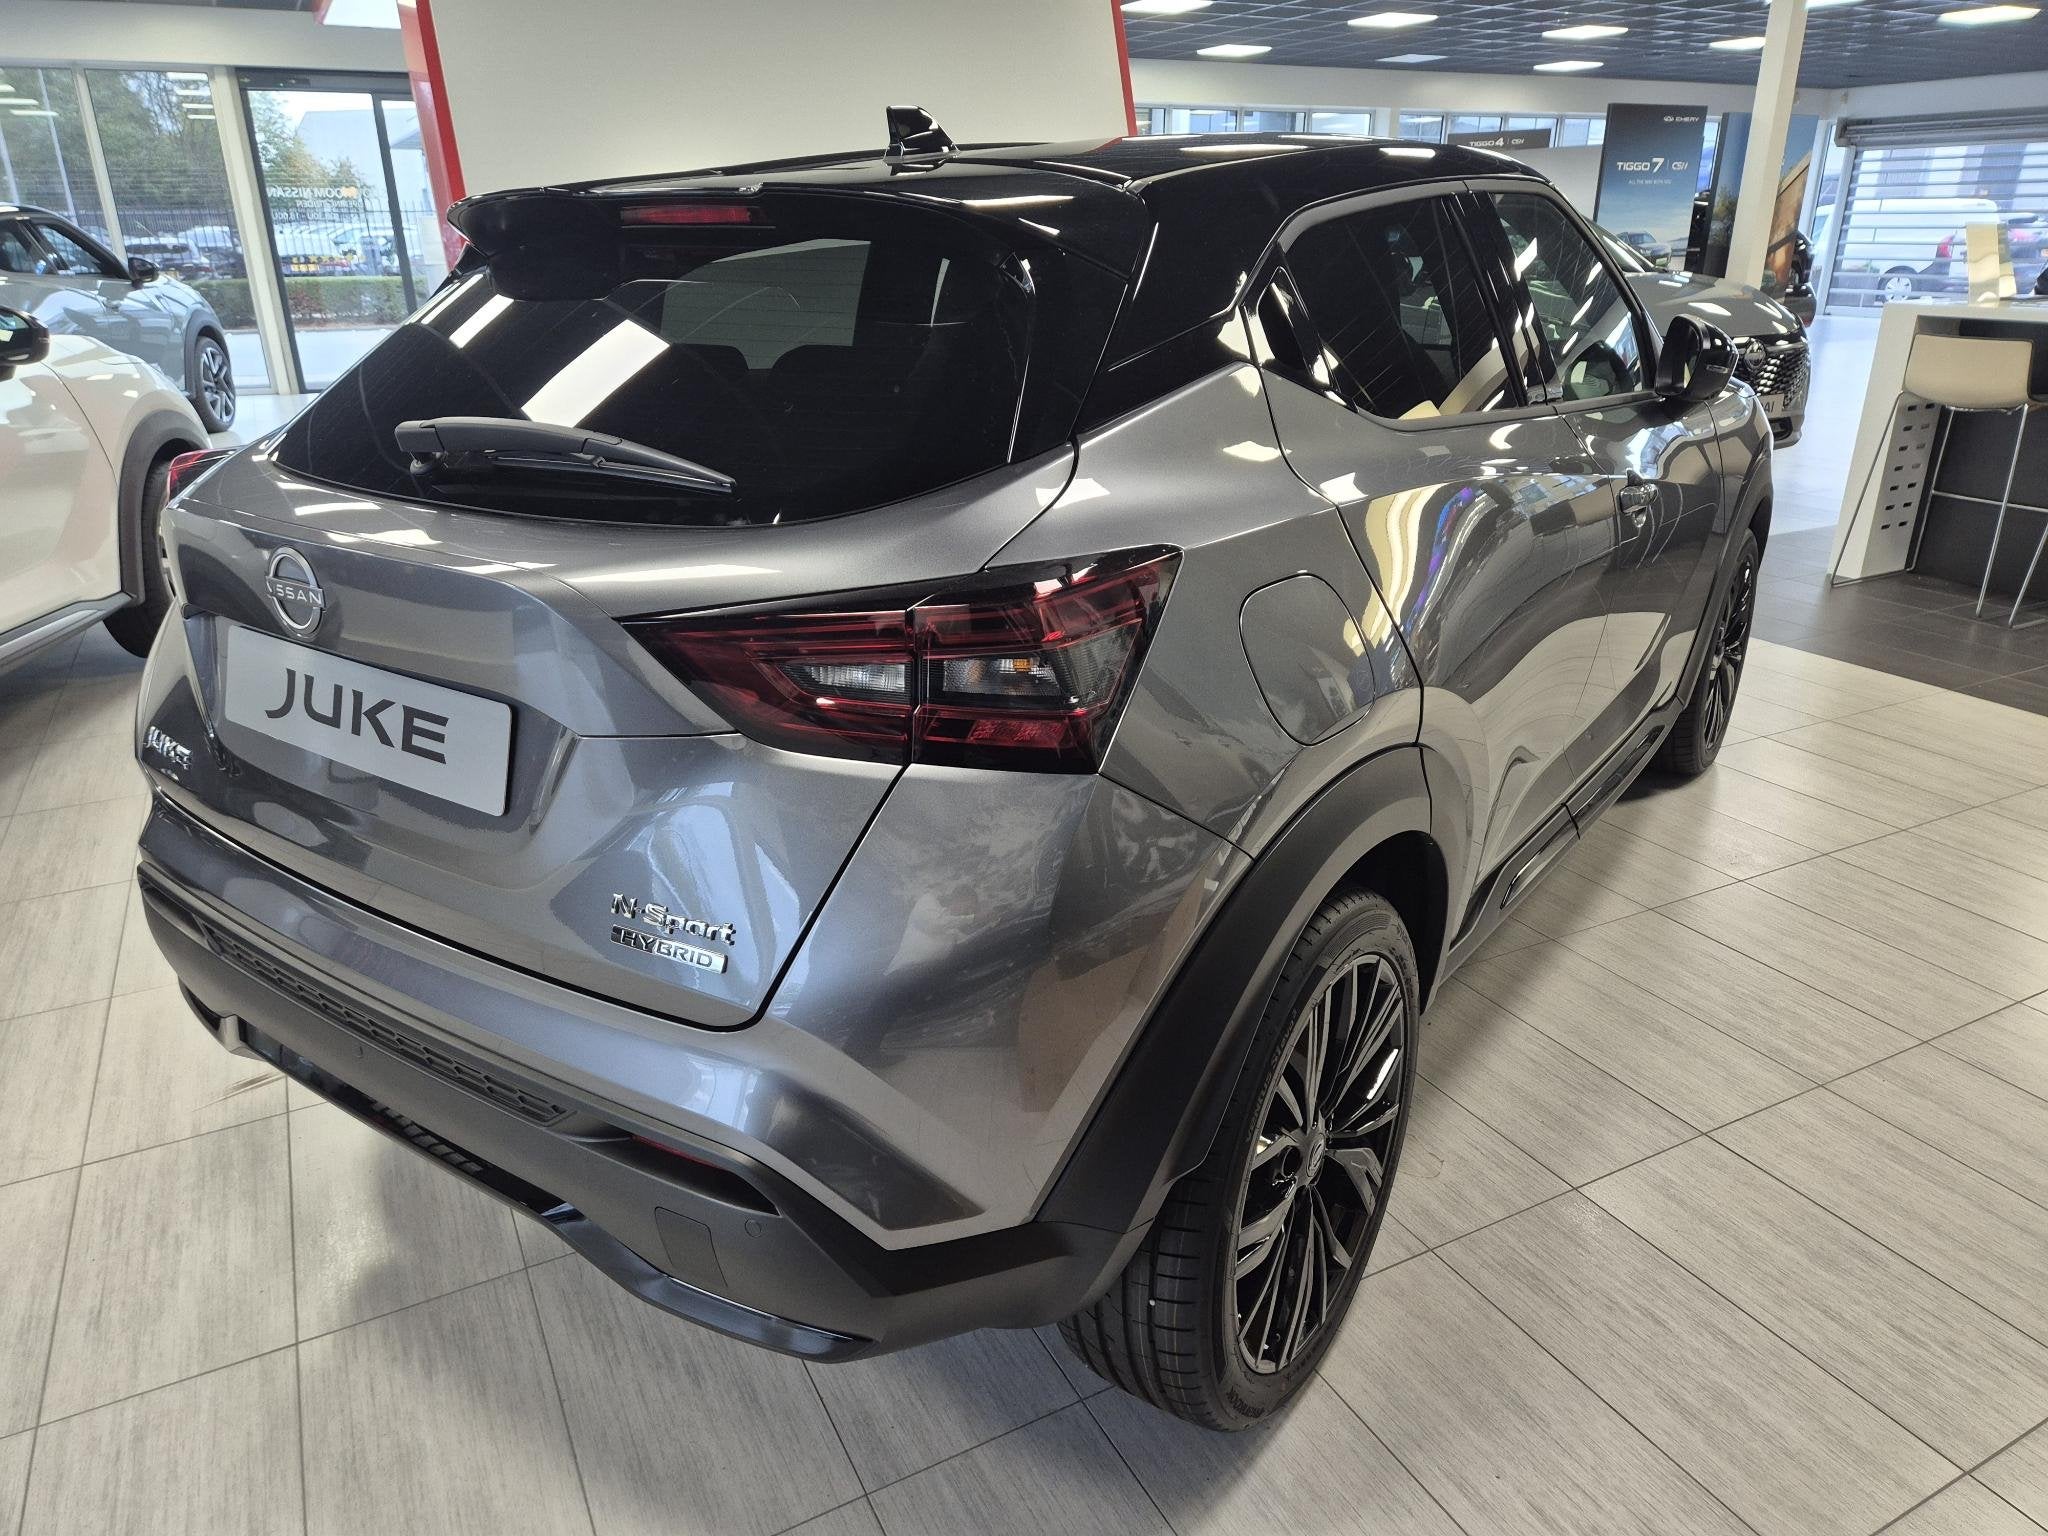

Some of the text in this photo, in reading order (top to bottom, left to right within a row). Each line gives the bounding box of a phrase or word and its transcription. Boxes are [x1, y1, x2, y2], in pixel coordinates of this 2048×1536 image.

[1495, 137, 1505, 147] 4
[1616, 161, 1651, 171] TIGGO
[1651, 157, 1665, 173] 7
[265, 668, 449, 765] JUKE
[620, 929, 713, 968] HYBRID
